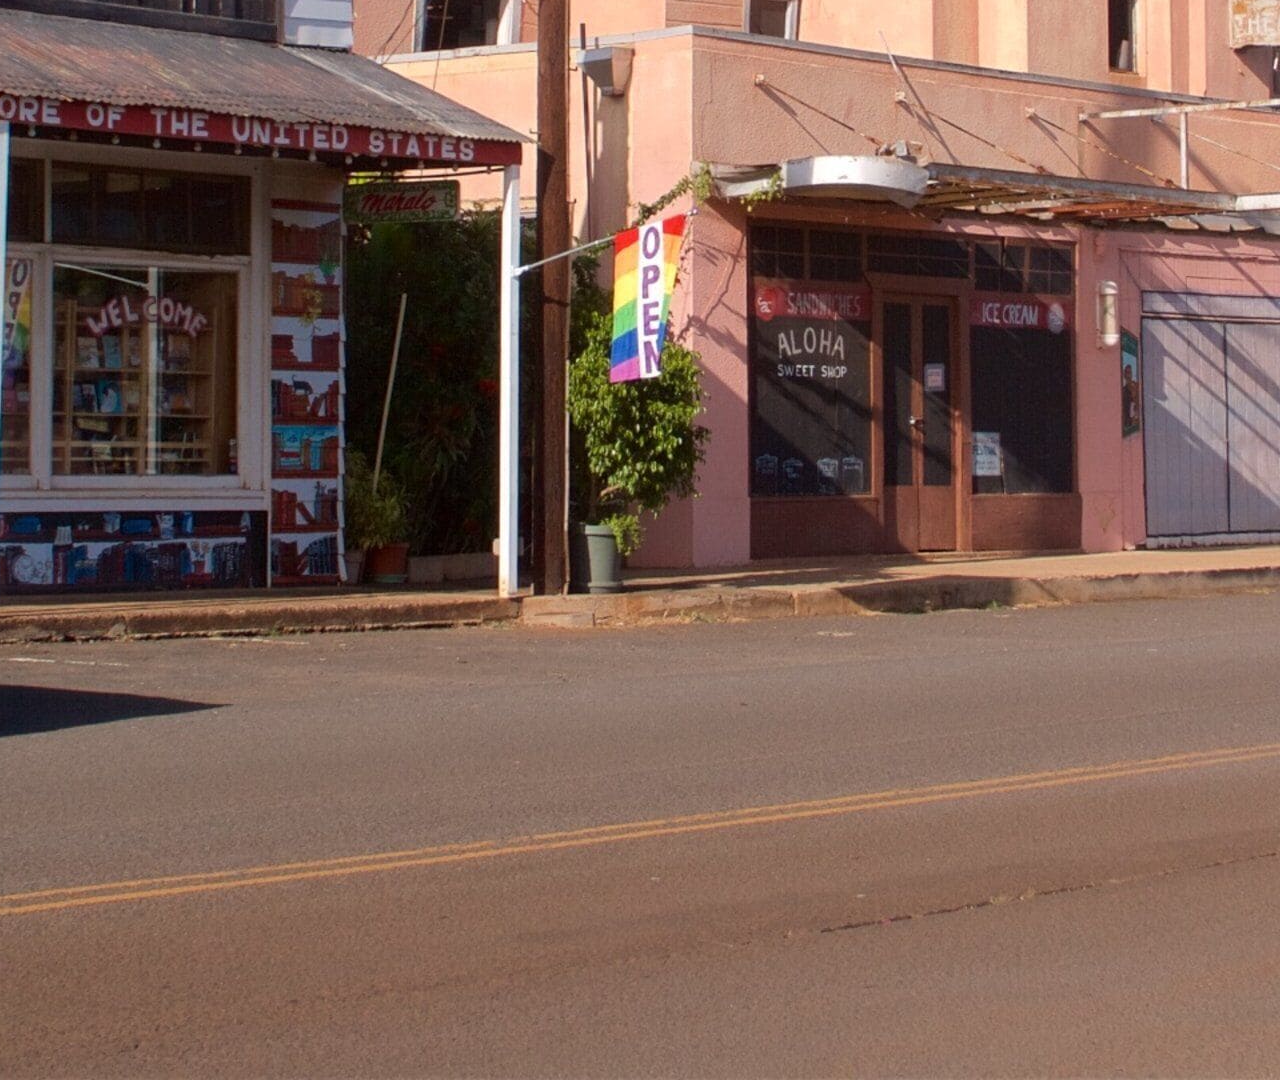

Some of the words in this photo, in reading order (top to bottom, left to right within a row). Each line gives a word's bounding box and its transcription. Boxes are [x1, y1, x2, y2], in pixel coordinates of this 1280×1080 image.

[86, 102, 126, 130] OF
[151, 108, 209, 138] THE
[231, 120, 349, 150] UNITED
[368, 130, 475, 161] STATES
[86, 295, 209, 339] WELCOME
[642, 226, 661, 374] OPEN
[982, 302, 1000, 324] ICE
[1002, 304, 1039, 326] CREAM
[778, 326, 845, 360] ALOHA
[777, 363, 815, 377] SWEET
[821, 364, 848, 378] SHOP
